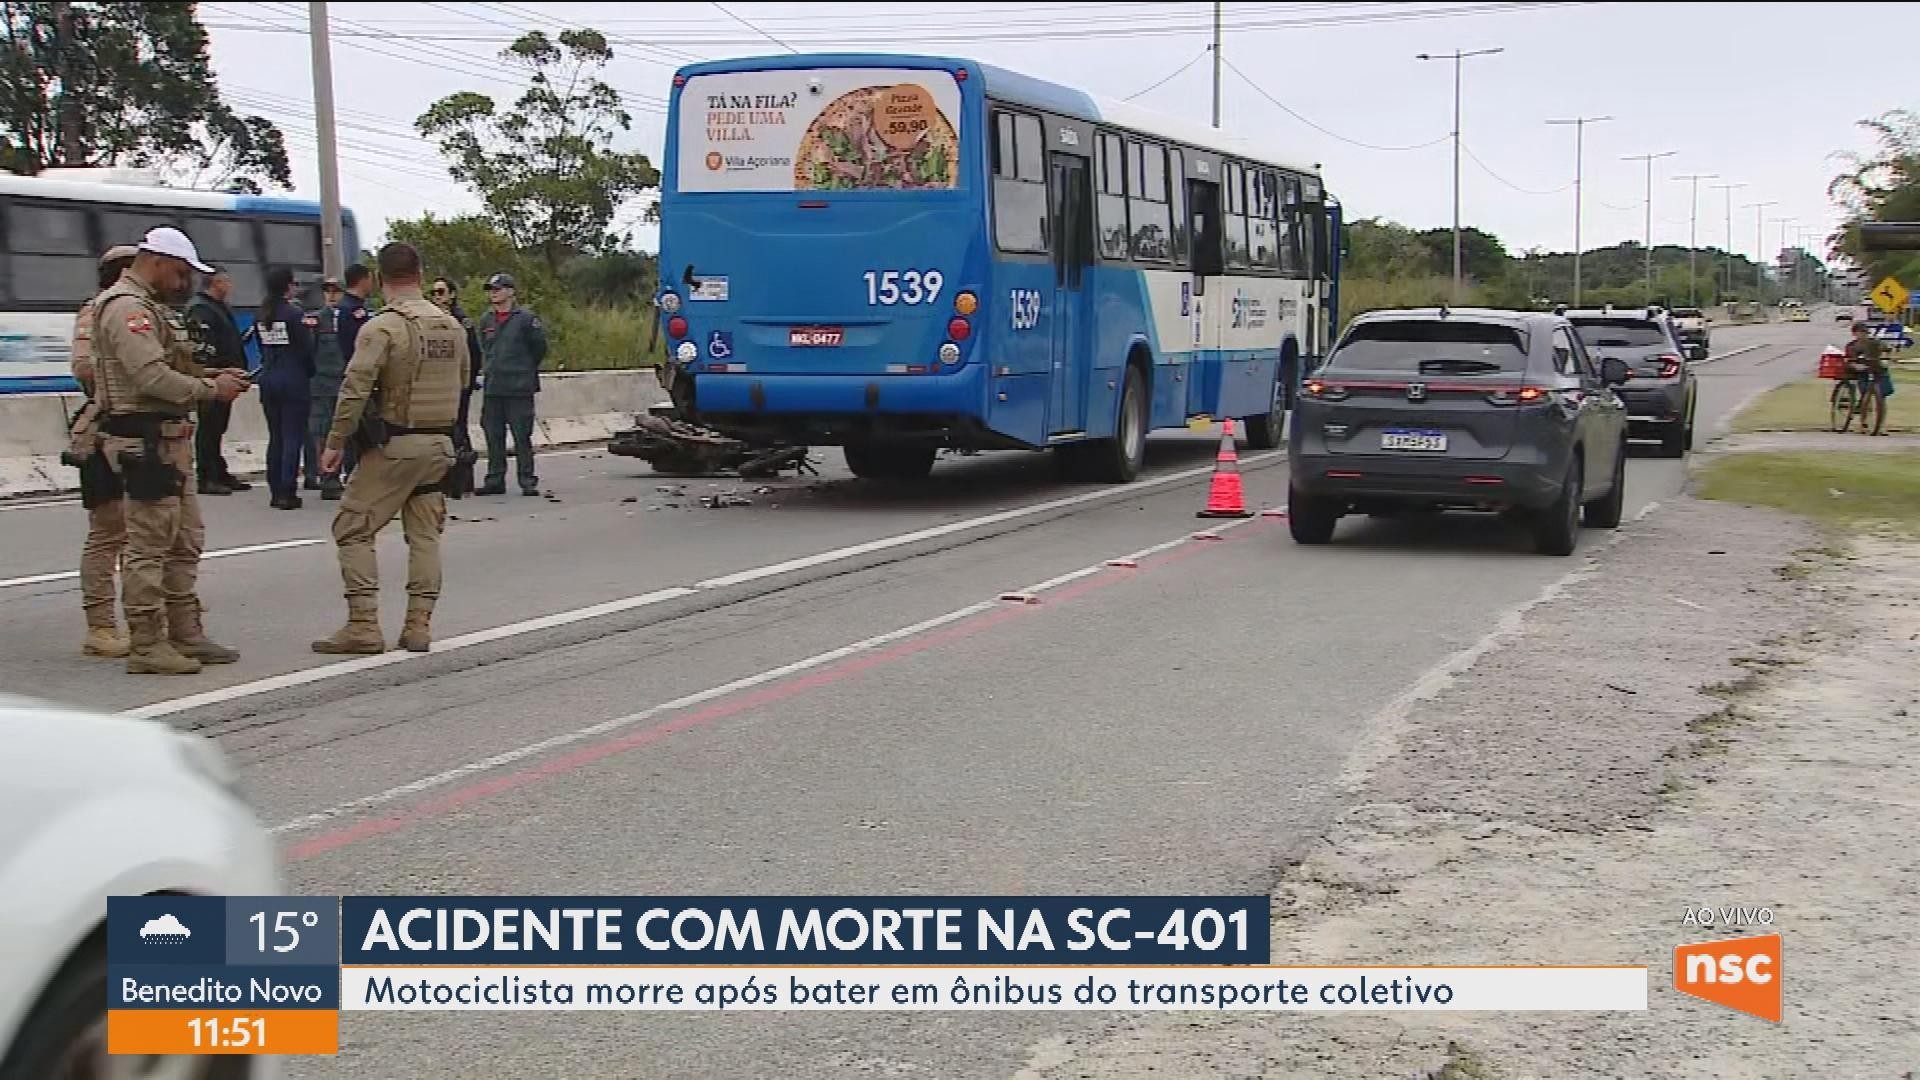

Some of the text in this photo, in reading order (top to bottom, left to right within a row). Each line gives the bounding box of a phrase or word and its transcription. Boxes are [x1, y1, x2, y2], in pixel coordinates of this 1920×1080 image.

[707, 91, 797, 109] TÁ NA FILA?
[706, 111, 786, 125] PEDE UMA
[706, 128, 755, 141] VILLA.
[725, 155, 745, 167] Villa
[863, 270, 944, 306] 1539
[1009, 288, 1041, 330] 1539
